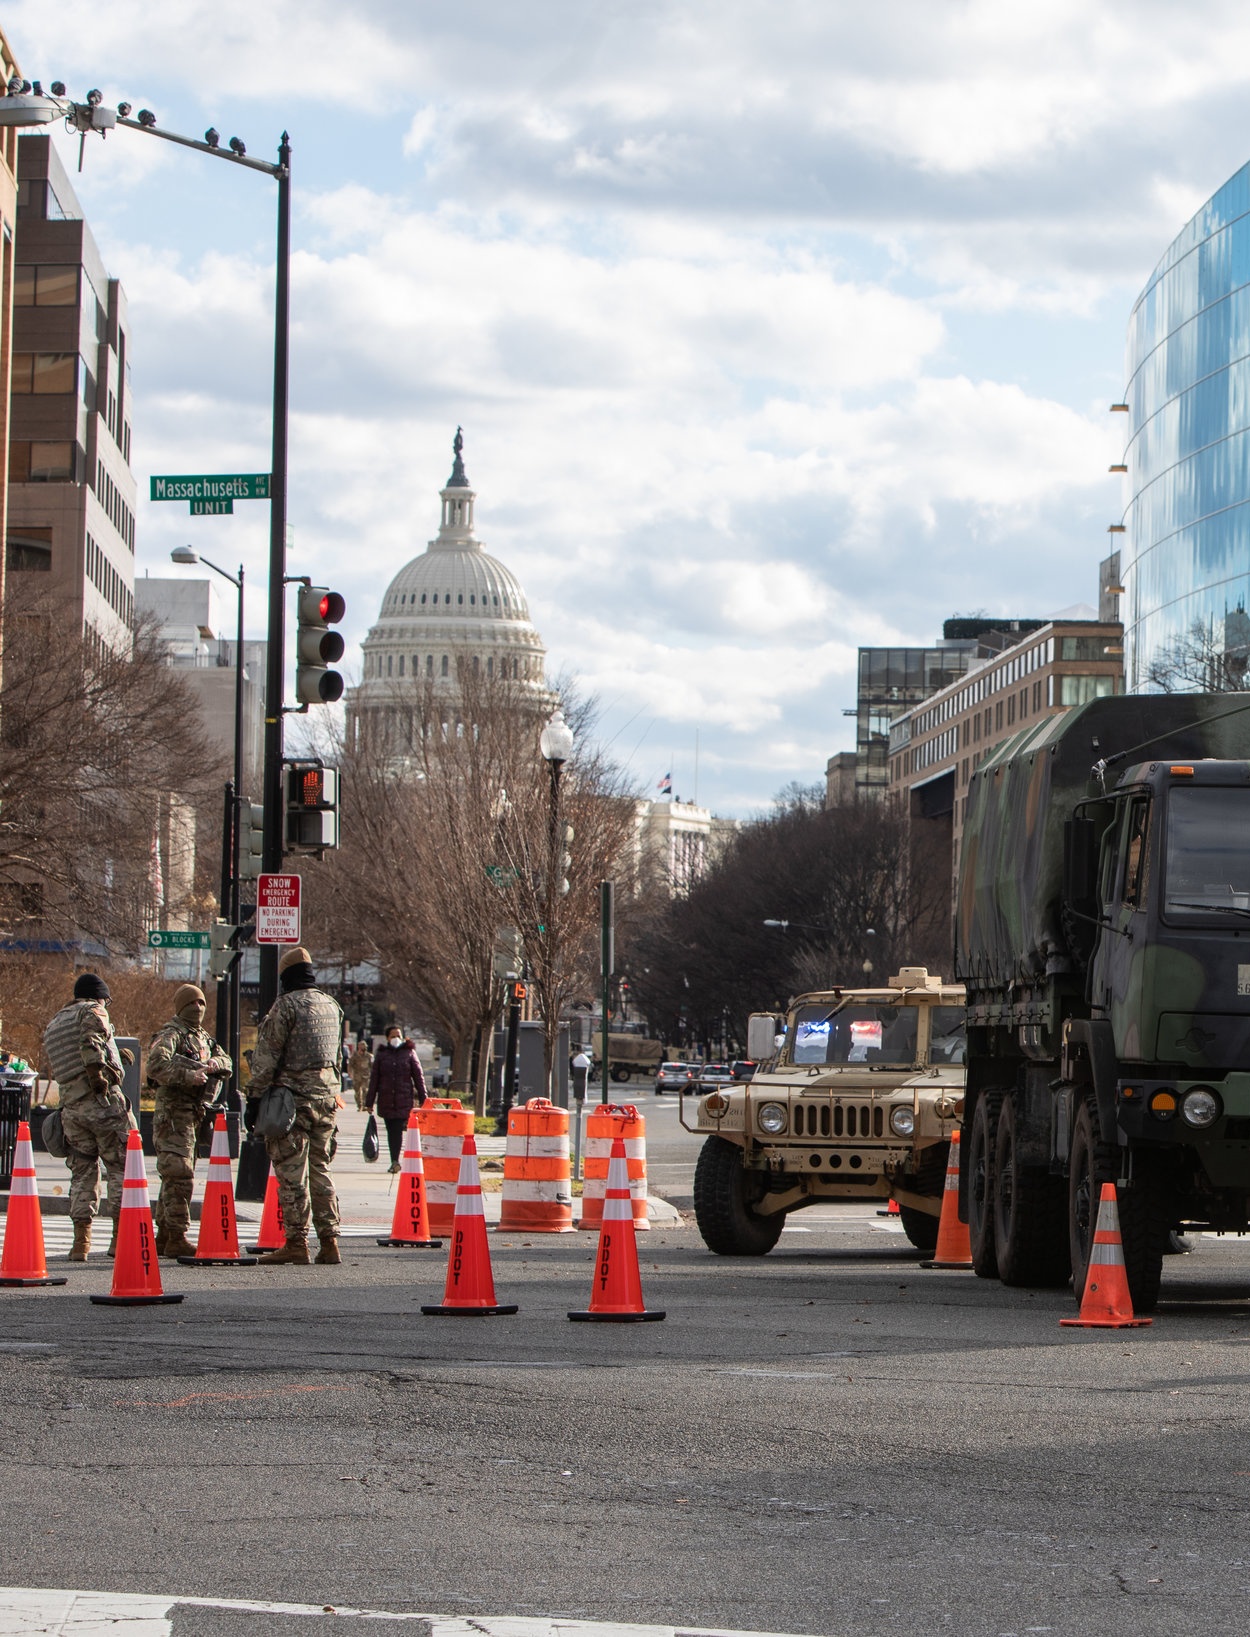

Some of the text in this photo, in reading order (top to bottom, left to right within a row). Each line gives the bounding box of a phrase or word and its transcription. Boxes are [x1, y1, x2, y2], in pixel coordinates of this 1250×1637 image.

[156, 476, 265, 498] Massachusetts AVE
[255, 487, 266, 496] NW
[194, 501, 228, 515] UNIT
[267, 878, 291, 888] SNOW
[267, 896, 290, 906] ROUTE
[262, 908, 295, 916] NO PARKING
[266, 918, 290, 926] DURING
[261, 927, 296, 936] EMERGENCY
[172, 936, 196, 944] BLOCKS
[410, 1176, 421, 1234] DDOT
[220, 1194, 228, 1241] DDOT
[139, 1222, 151, 1275] DDOT
[453, 1230, 463, 1285] DDOT
[600, 1235, 611, 1290] DDOT
